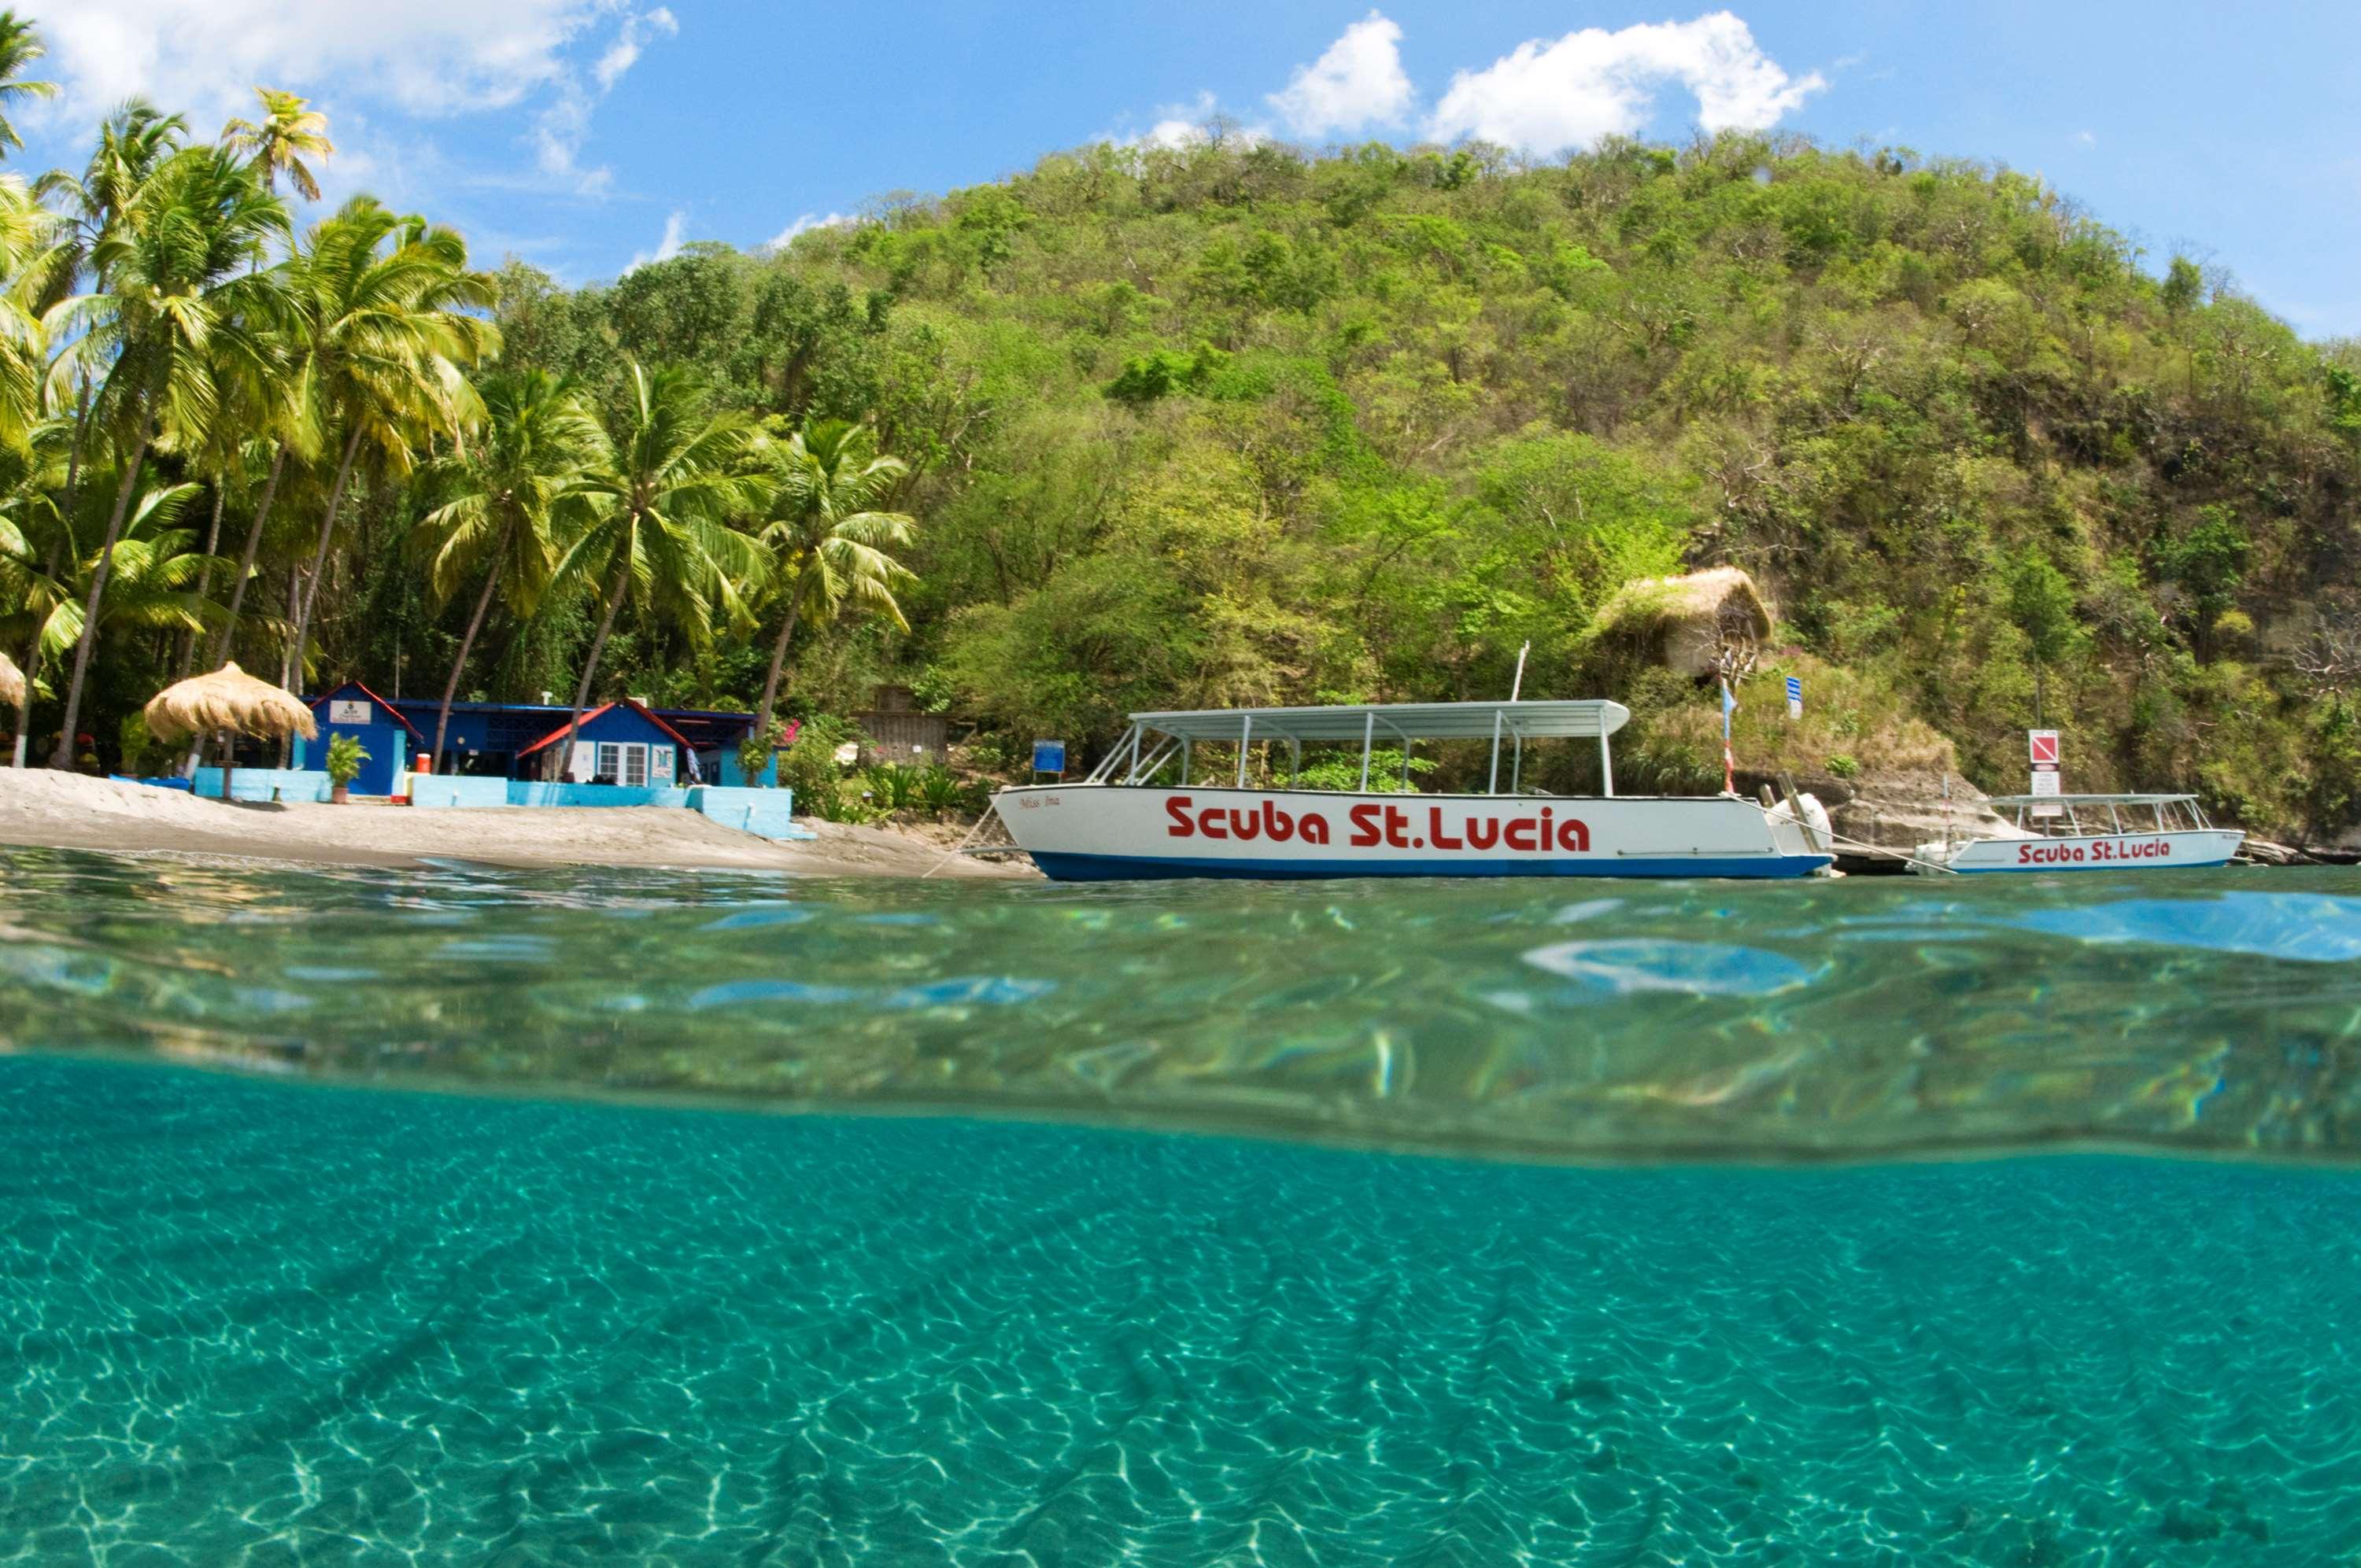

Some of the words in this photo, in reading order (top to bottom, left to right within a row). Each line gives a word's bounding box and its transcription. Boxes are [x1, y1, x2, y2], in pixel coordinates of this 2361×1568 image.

[1020, 796, 1040, 810] Miss
[1166, 796, 1330, 845] Scuba
[1349, 803, 1591, 852] St.Lucia
[2018, 843, 2085, 864] Scuba
[2091, 838, 2171, 861] St.Lucia
